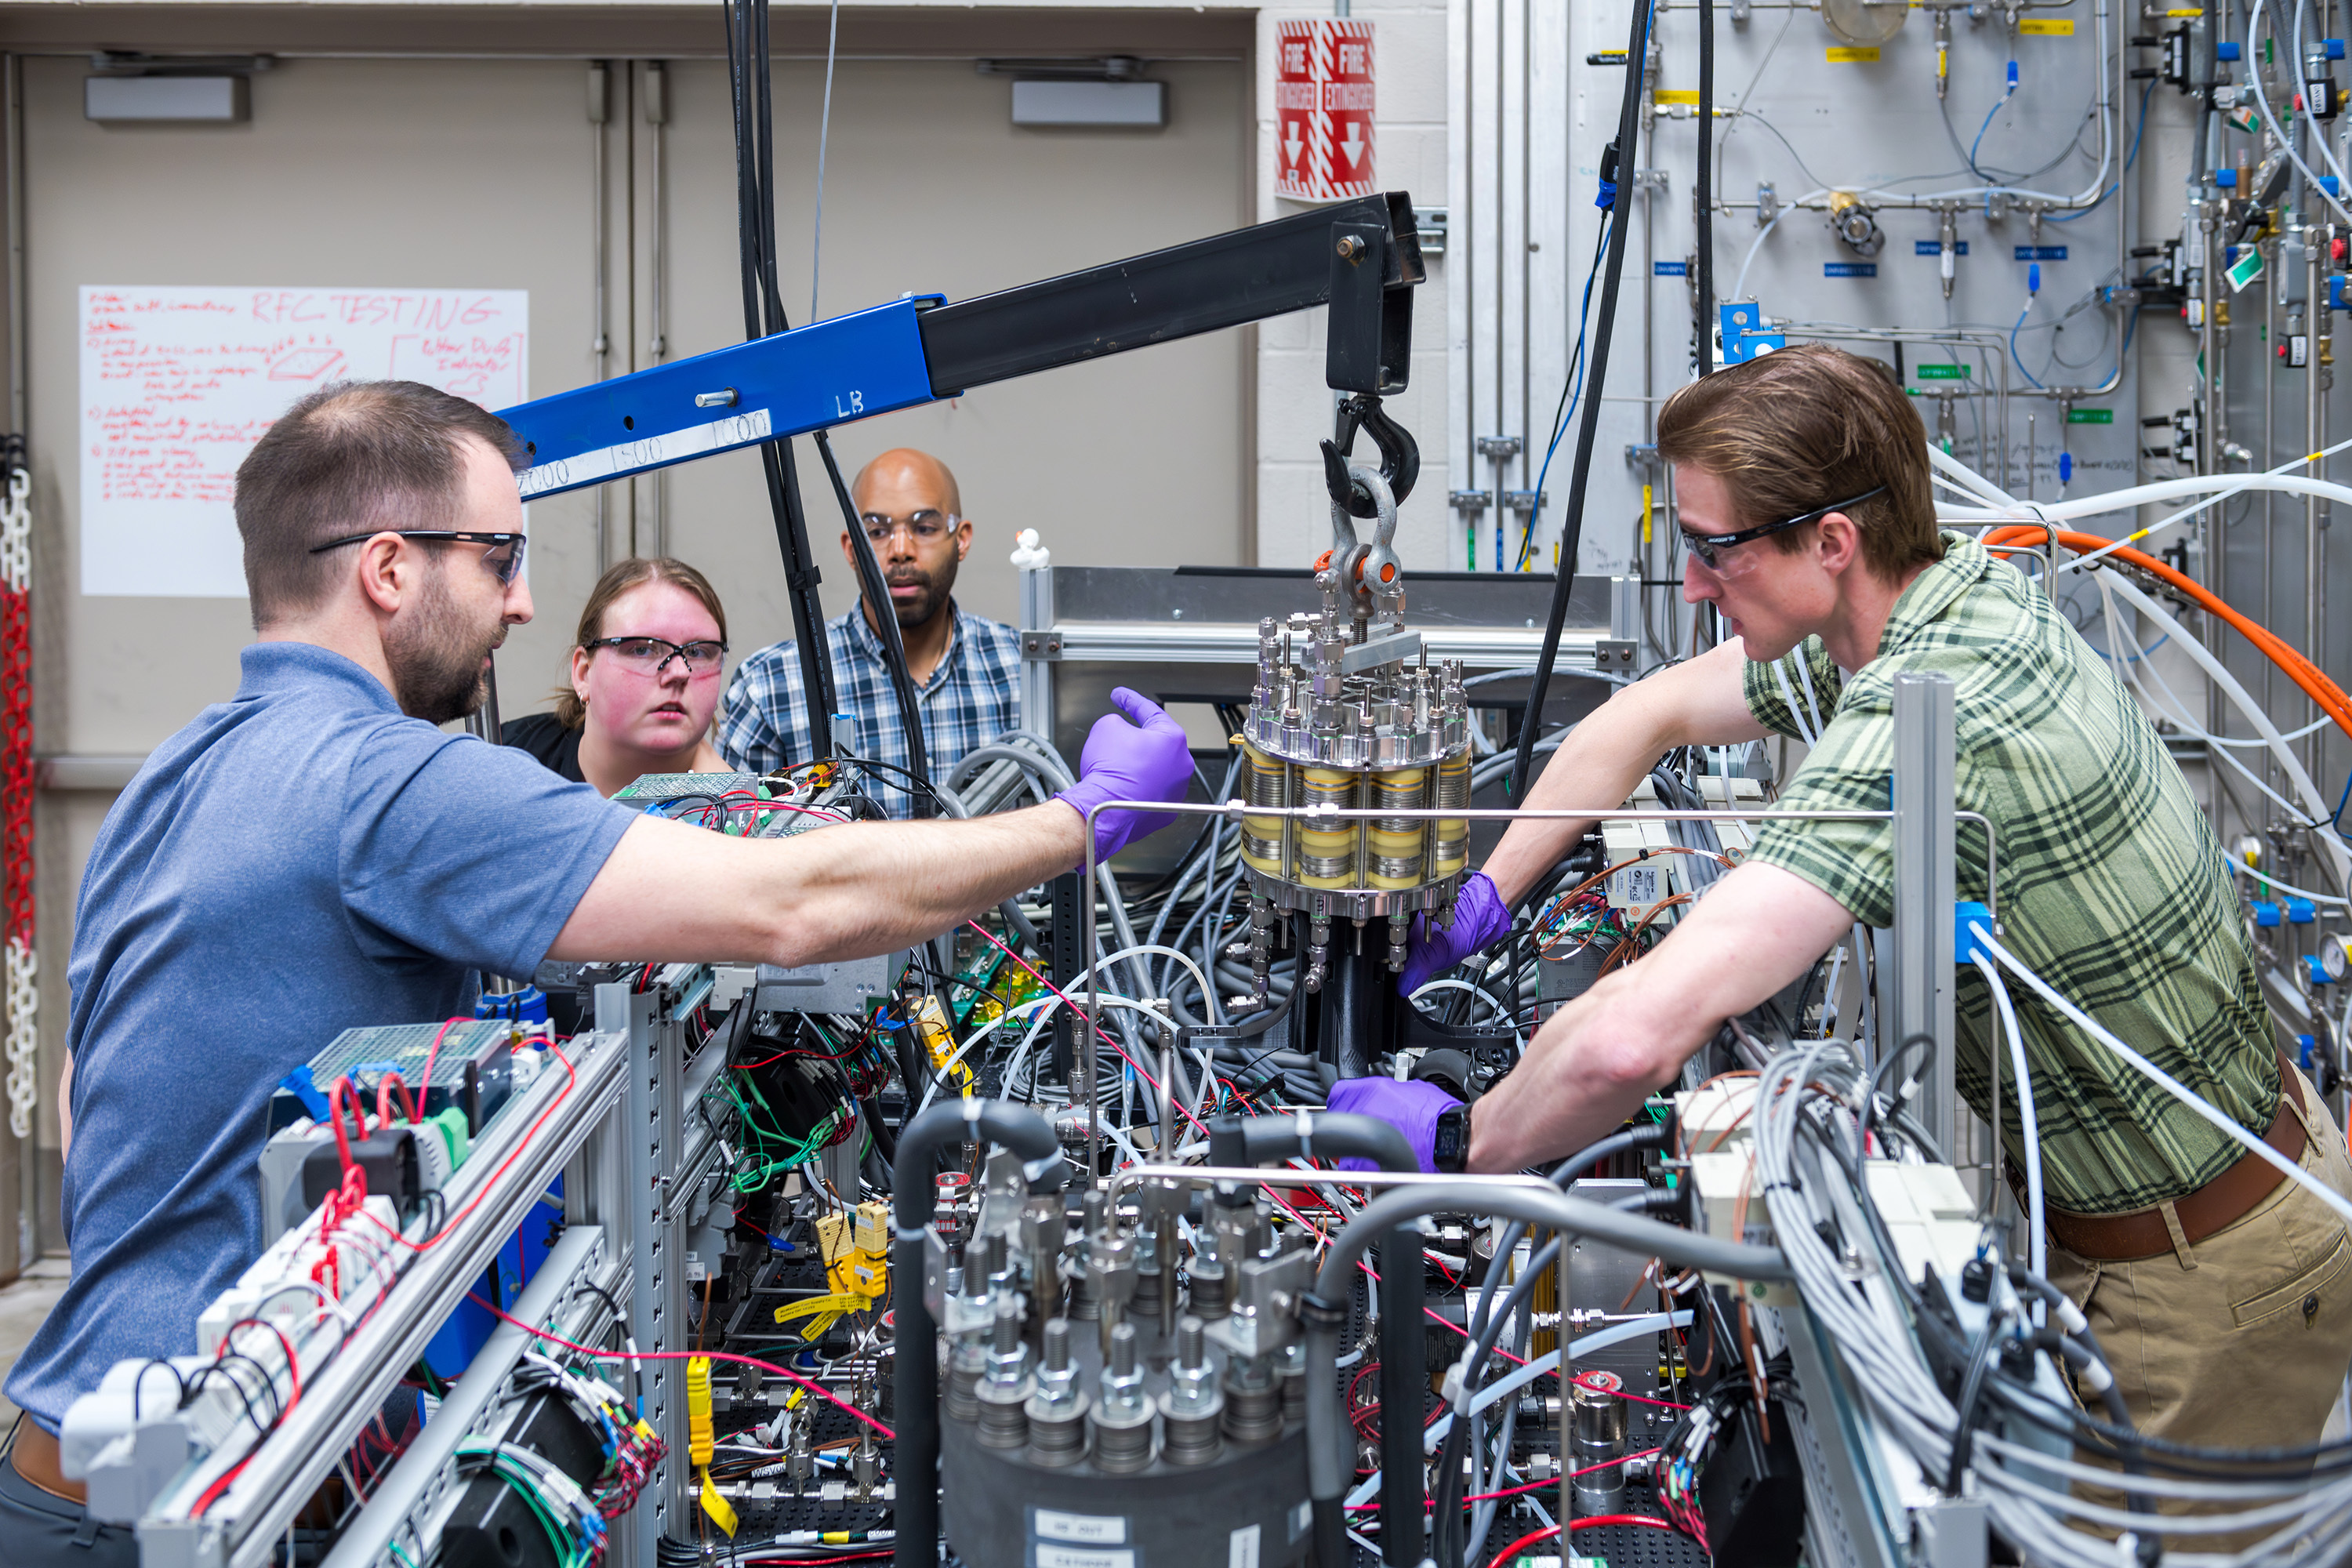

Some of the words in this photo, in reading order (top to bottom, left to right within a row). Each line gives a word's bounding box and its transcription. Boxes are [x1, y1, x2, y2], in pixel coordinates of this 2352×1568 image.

[1284, 43, 1306, 73] FIRE
[1338, 44, 1365, 74] FIRE
[252, 292, 326, 324] RFC
[330, 295, 502, 331] TESTING
[835, 390, 864, 418] LB
[712, 412, 767, 448] 1000
